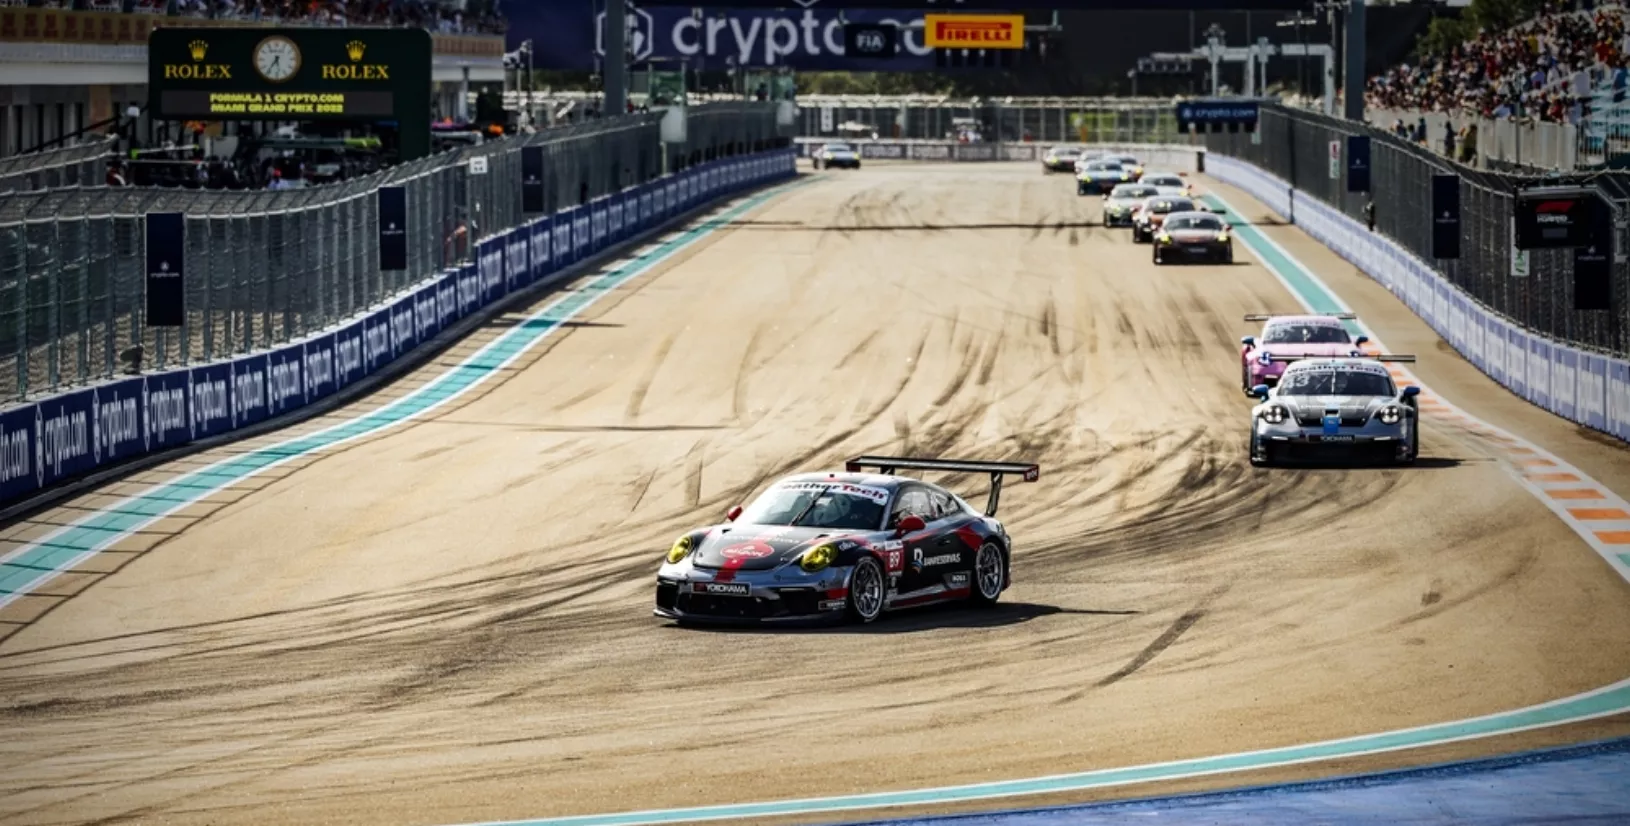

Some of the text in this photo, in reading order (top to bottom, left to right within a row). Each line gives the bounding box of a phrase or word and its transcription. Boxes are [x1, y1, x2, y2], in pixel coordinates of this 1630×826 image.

[936, 22, 1012, 41] PIRELLI
[856, 35, 883, 48] FIA
[164, 65, 232, 79] ROLEX
[322, 65, 389, 79] ROLEX
[210, 94, 344, 103] FORMULA 1 CRYPTO.COM
[211, 104, 245, 112] MIAMI
[248, 104, 286, 112] GRAND
[288, 104, 314, 112] PRIX
[1195, 107, 1255, 119] crypto.com
[101, 391, 139, 458] crypto.com
[45, 405, 88, 477] crypto.com
[781, 482, 886, 500] eatherTech
[706, 584, 747, 594] YOKOHAMA
